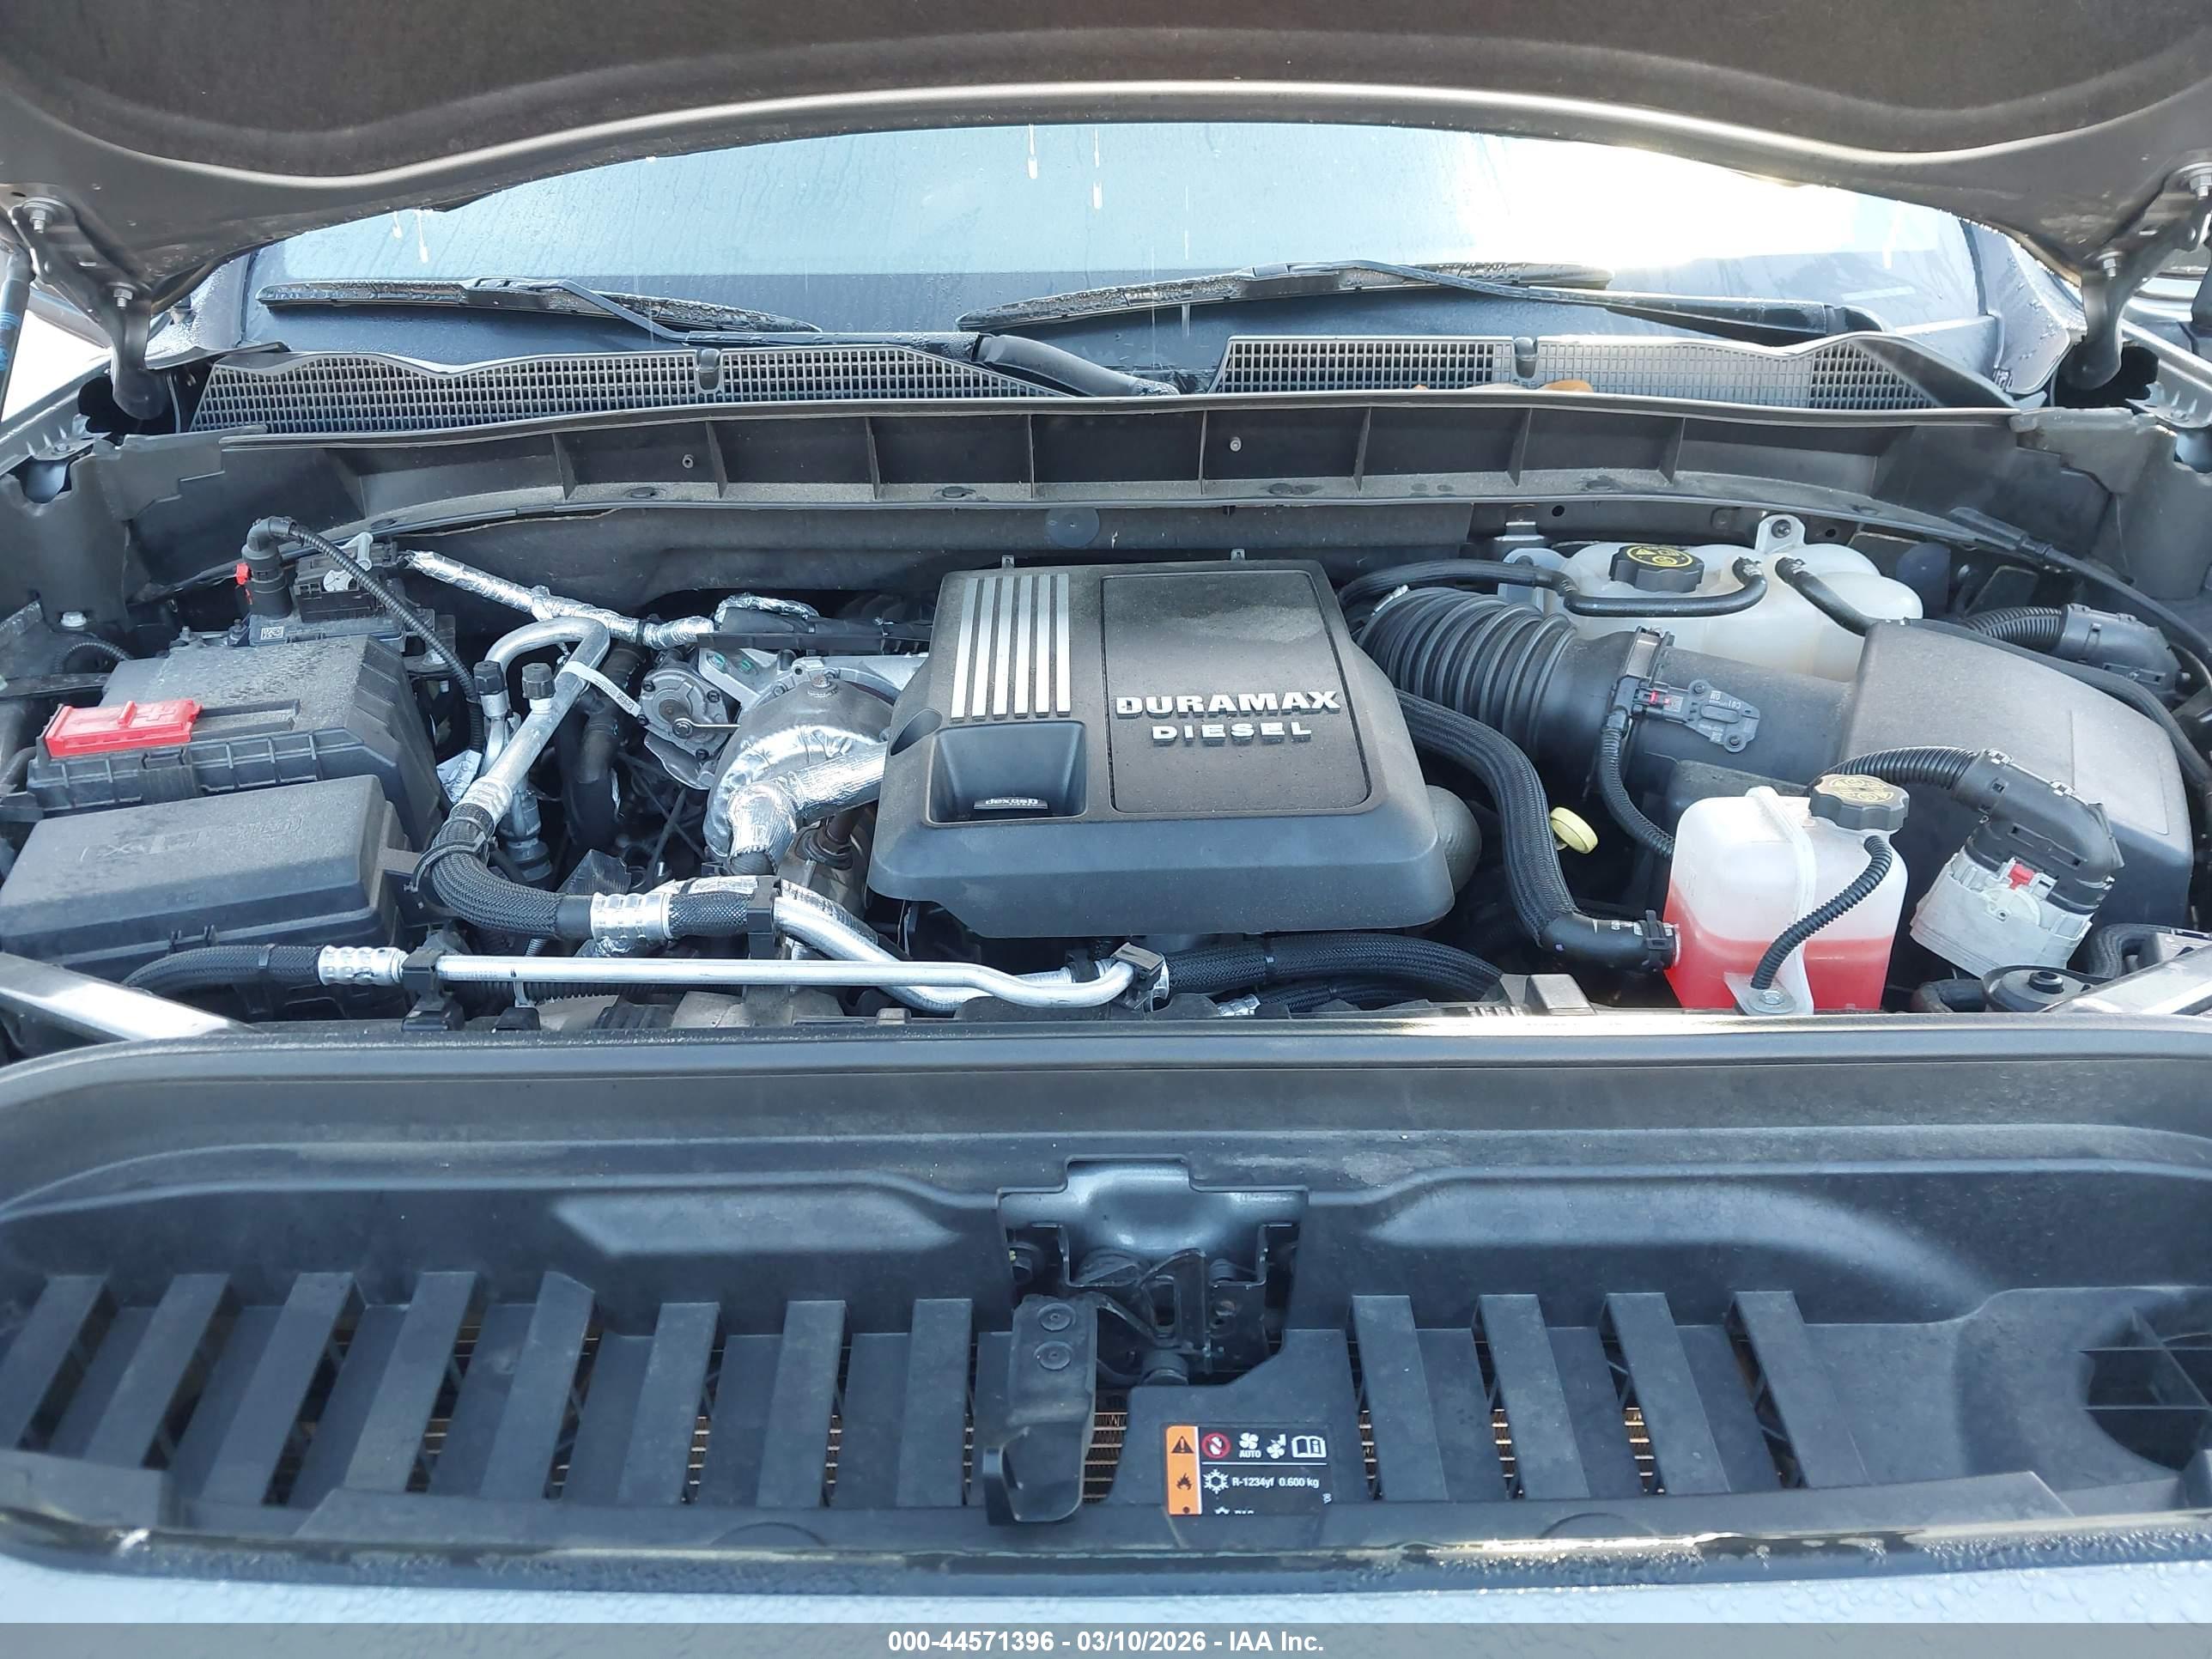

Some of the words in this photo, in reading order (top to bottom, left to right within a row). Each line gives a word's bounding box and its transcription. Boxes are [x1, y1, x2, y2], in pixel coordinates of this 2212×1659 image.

[1115, 690, 1341, 718] DURAMAX
[1152, 721, 1312, 742] DIESEL
[1238, 1449, 1261, 1458] AUTO
[1231, 1477, 1275, 1489] R-1234yf
[1279, 1477, 1305, 1487] 0.600
[1307, 1477, 1320, 1489] kg
